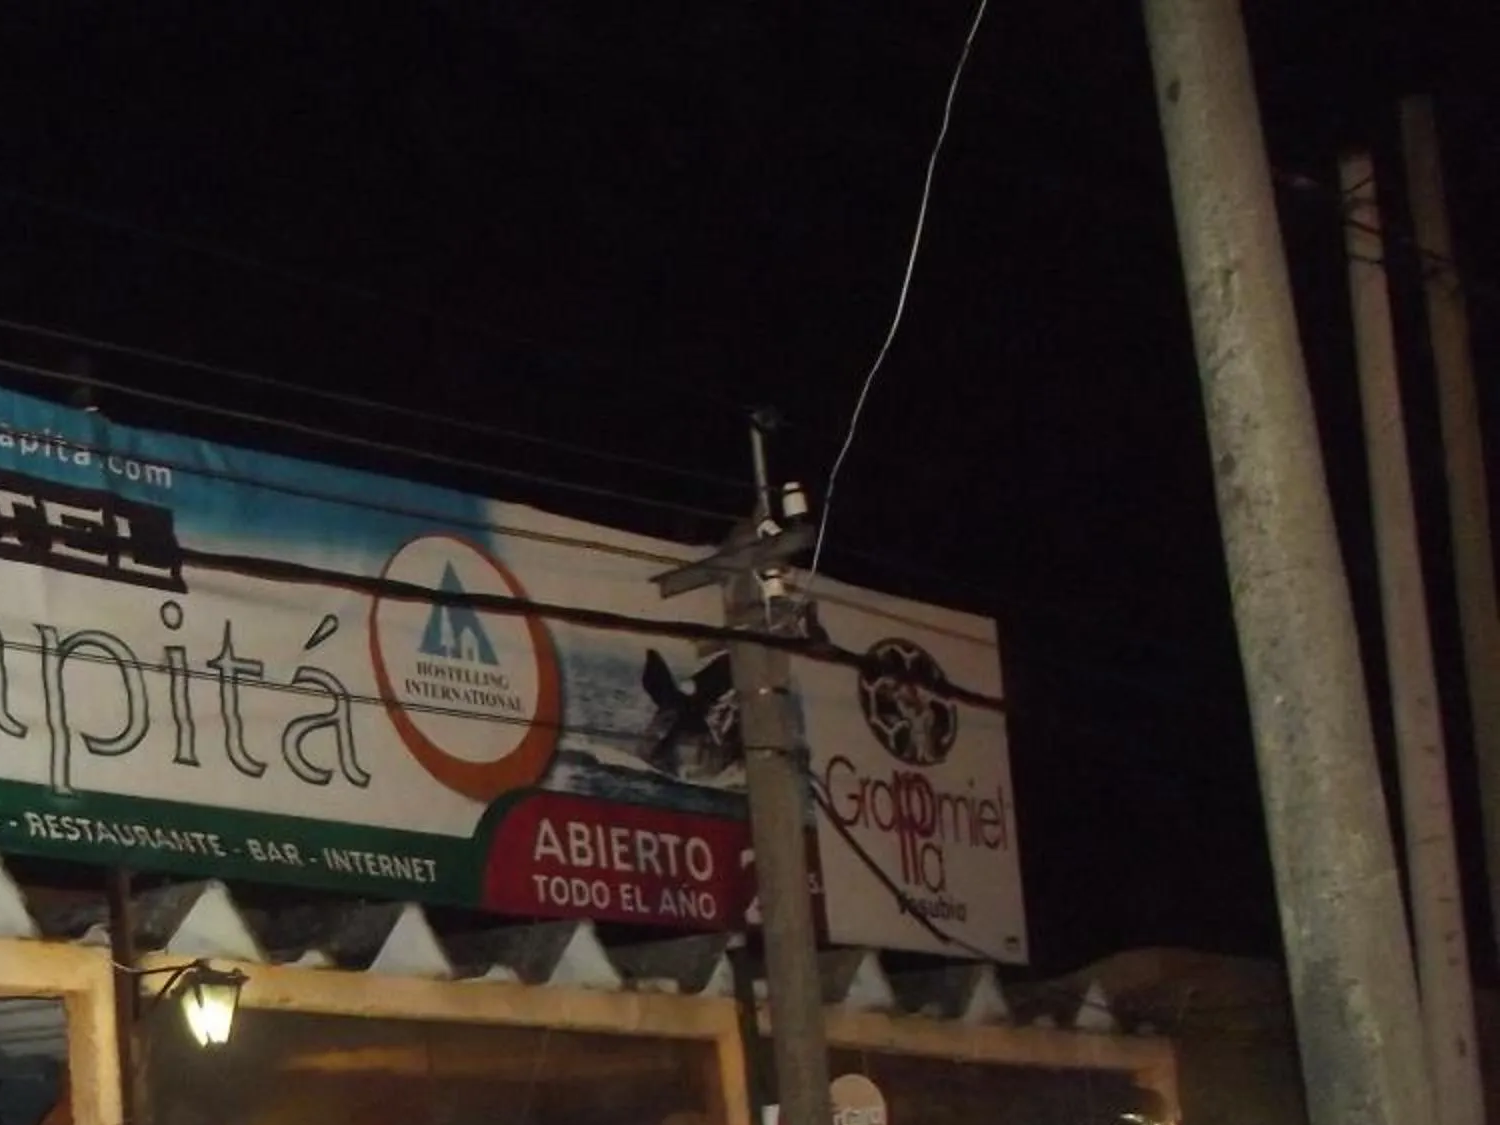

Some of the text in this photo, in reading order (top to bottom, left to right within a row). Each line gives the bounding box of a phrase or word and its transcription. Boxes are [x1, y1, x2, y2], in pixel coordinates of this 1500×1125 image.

[405, 679, 522, 711] INTERNATIONAL
[416, 661, 509, 690] HOSTELLING
[26, 811, 228, 858] RESTAURANTE
[246, 838, 306, 867] BAR
[323, 847, 438, 883] INTERNET
[533, 817, 713, 882] ABIERTO
[531, 873, 717, 920] TODO EL AÑO
